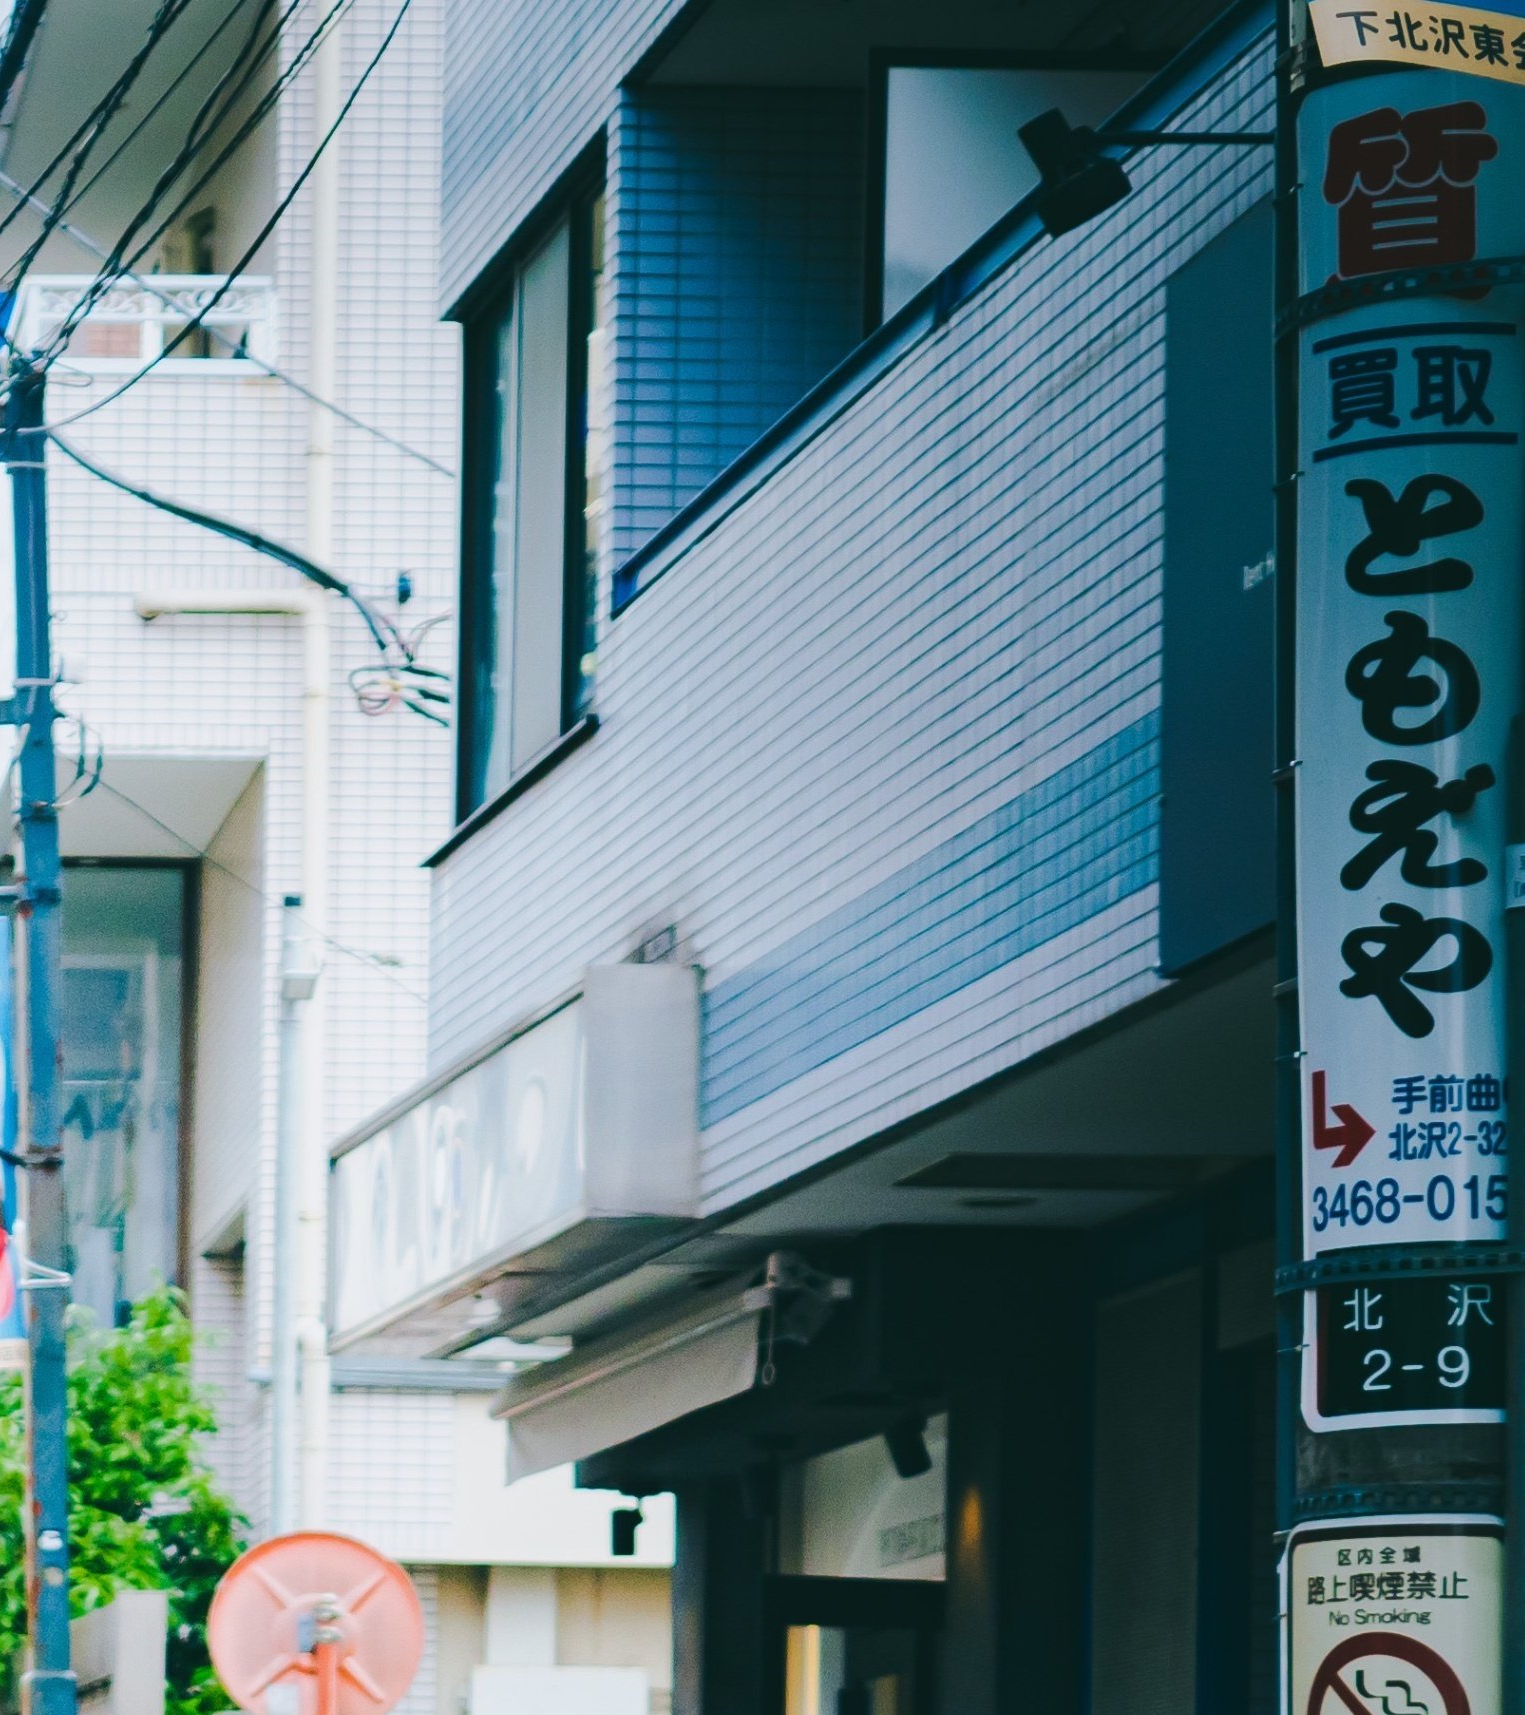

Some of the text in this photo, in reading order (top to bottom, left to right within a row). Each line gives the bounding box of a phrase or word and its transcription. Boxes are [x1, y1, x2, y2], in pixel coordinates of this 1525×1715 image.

[1323, 100, 1498, 300] 質
[1328, 345, 1495, 441] 買取
[1392, 1074, 1508, 1115] 手前曲
[1343, 1284, 1494, 1332] 北沢
[1363, 1345, 1472, 1391] 2-9
[1307, 1570, 1469, 1605] 路上喫煙禁止
[1329, 1608, 1431, 1626] No Smoking
